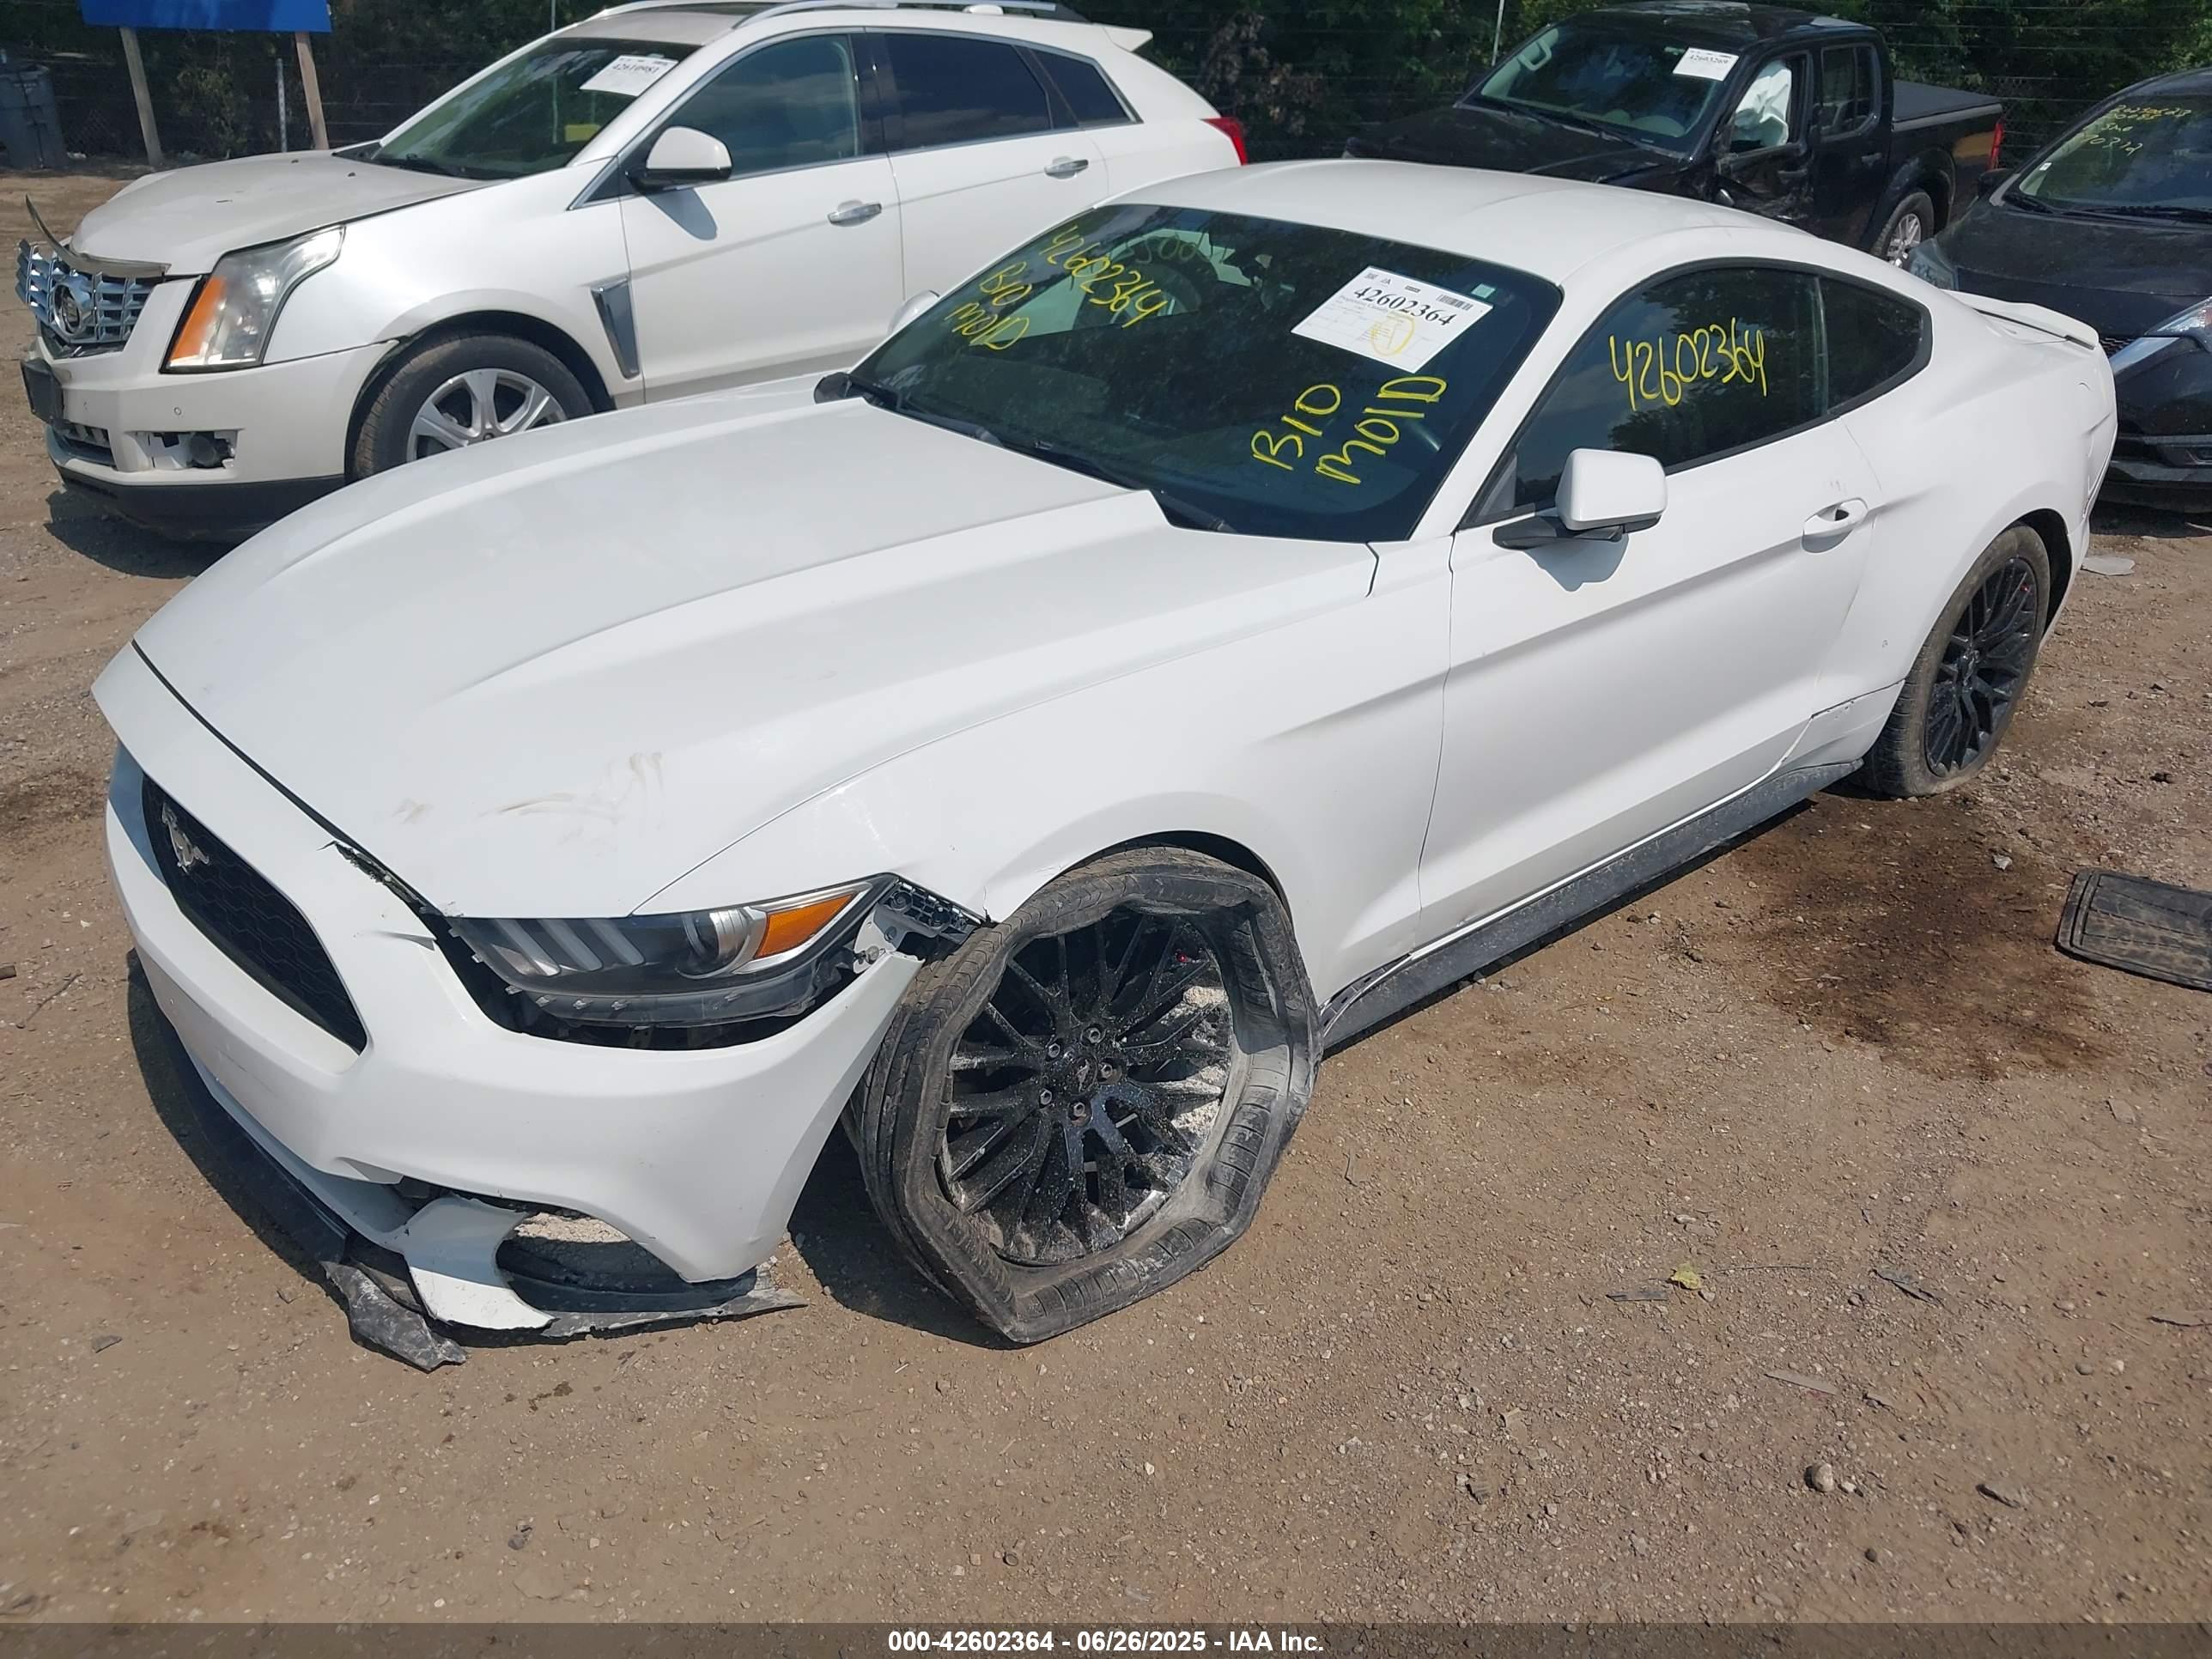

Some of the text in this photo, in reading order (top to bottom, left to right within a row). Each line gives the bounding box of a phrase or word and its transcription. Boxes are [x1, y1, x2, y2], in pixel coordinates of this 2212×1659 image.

[1039, 225, 1169, 329] 42602364
[1353, 286, 1458, 327] 42602364
[1609, 316, 1768, 412] 42602364
